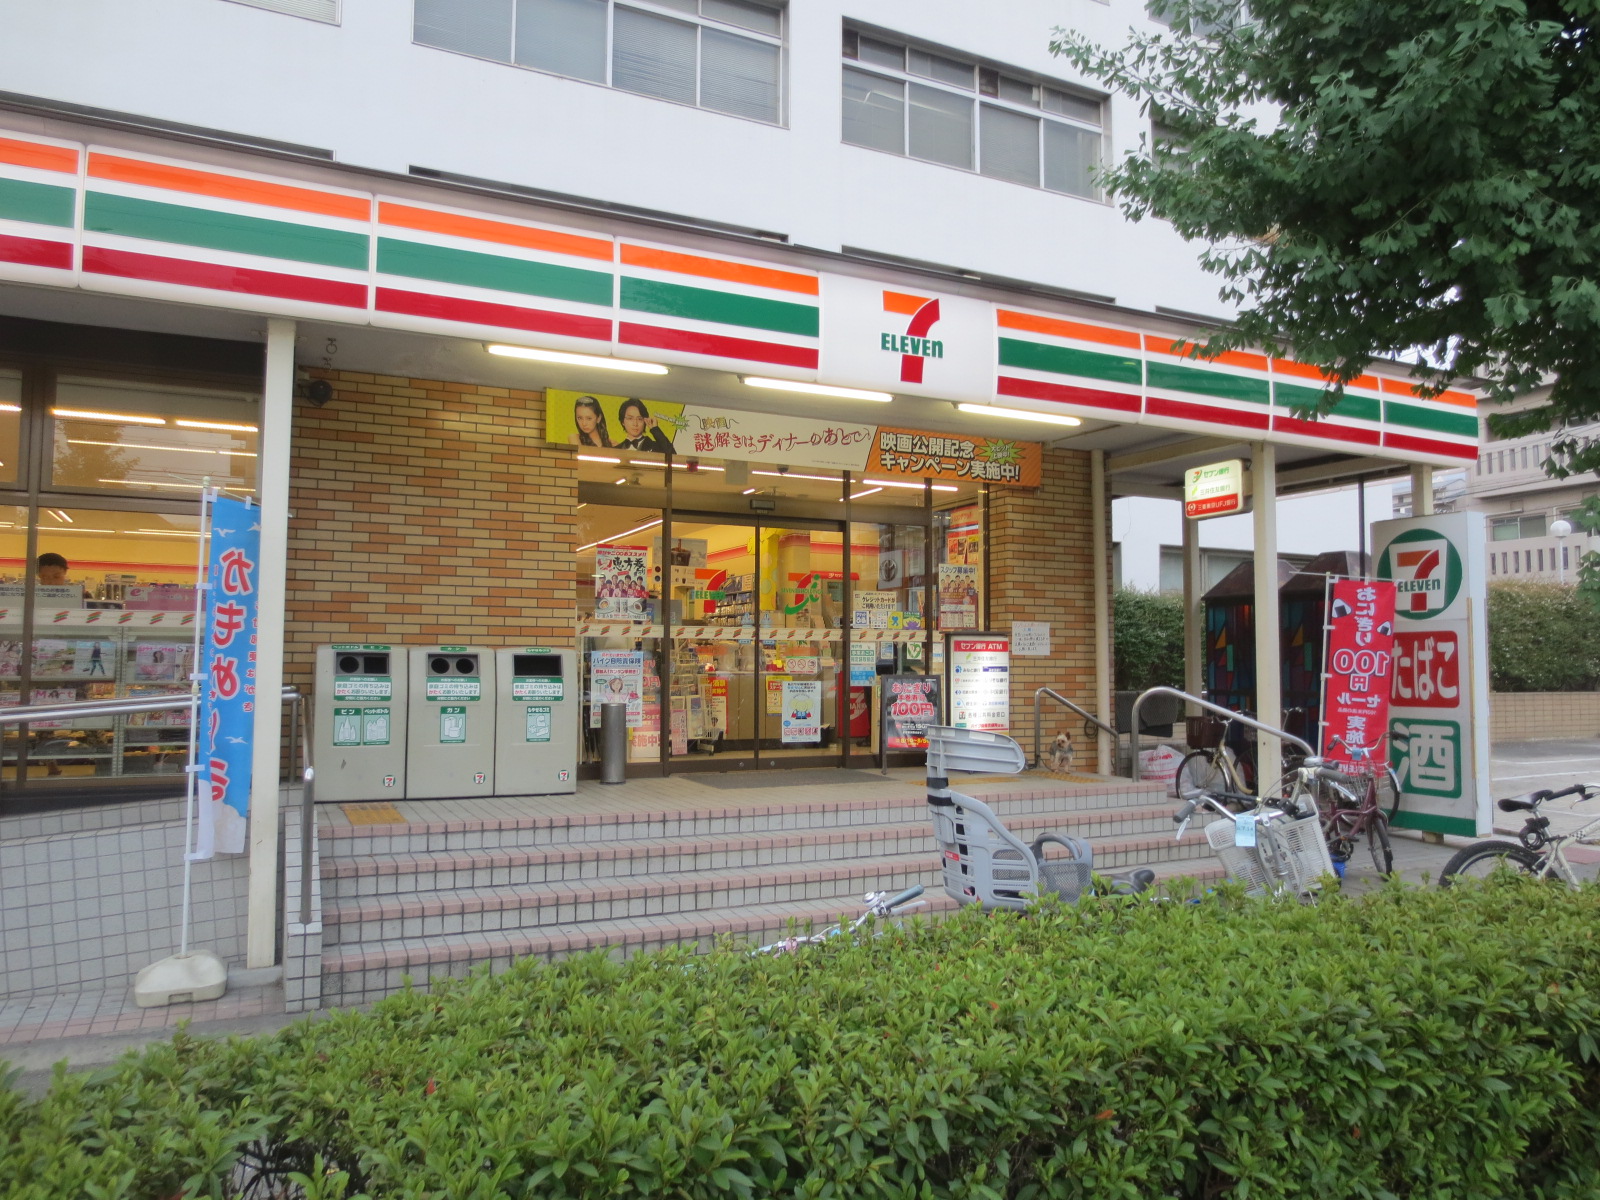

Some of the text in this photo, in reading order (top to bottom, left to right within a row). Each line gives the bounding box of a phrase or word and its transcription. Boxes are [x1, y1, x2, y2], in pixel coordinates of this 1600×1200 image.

[883, 290, 940, 384] 7
[880, 432, 975, 459] 映画公開記念
[880, 452, 1020, 482] キャンペーン実施中!
[1391, 636, 1458, 700] たばこ
[892, 682, 931, 693] おにぎり
[891, 702, 935, 717] 100円
[1393, 722, 1455, 792] 酒
